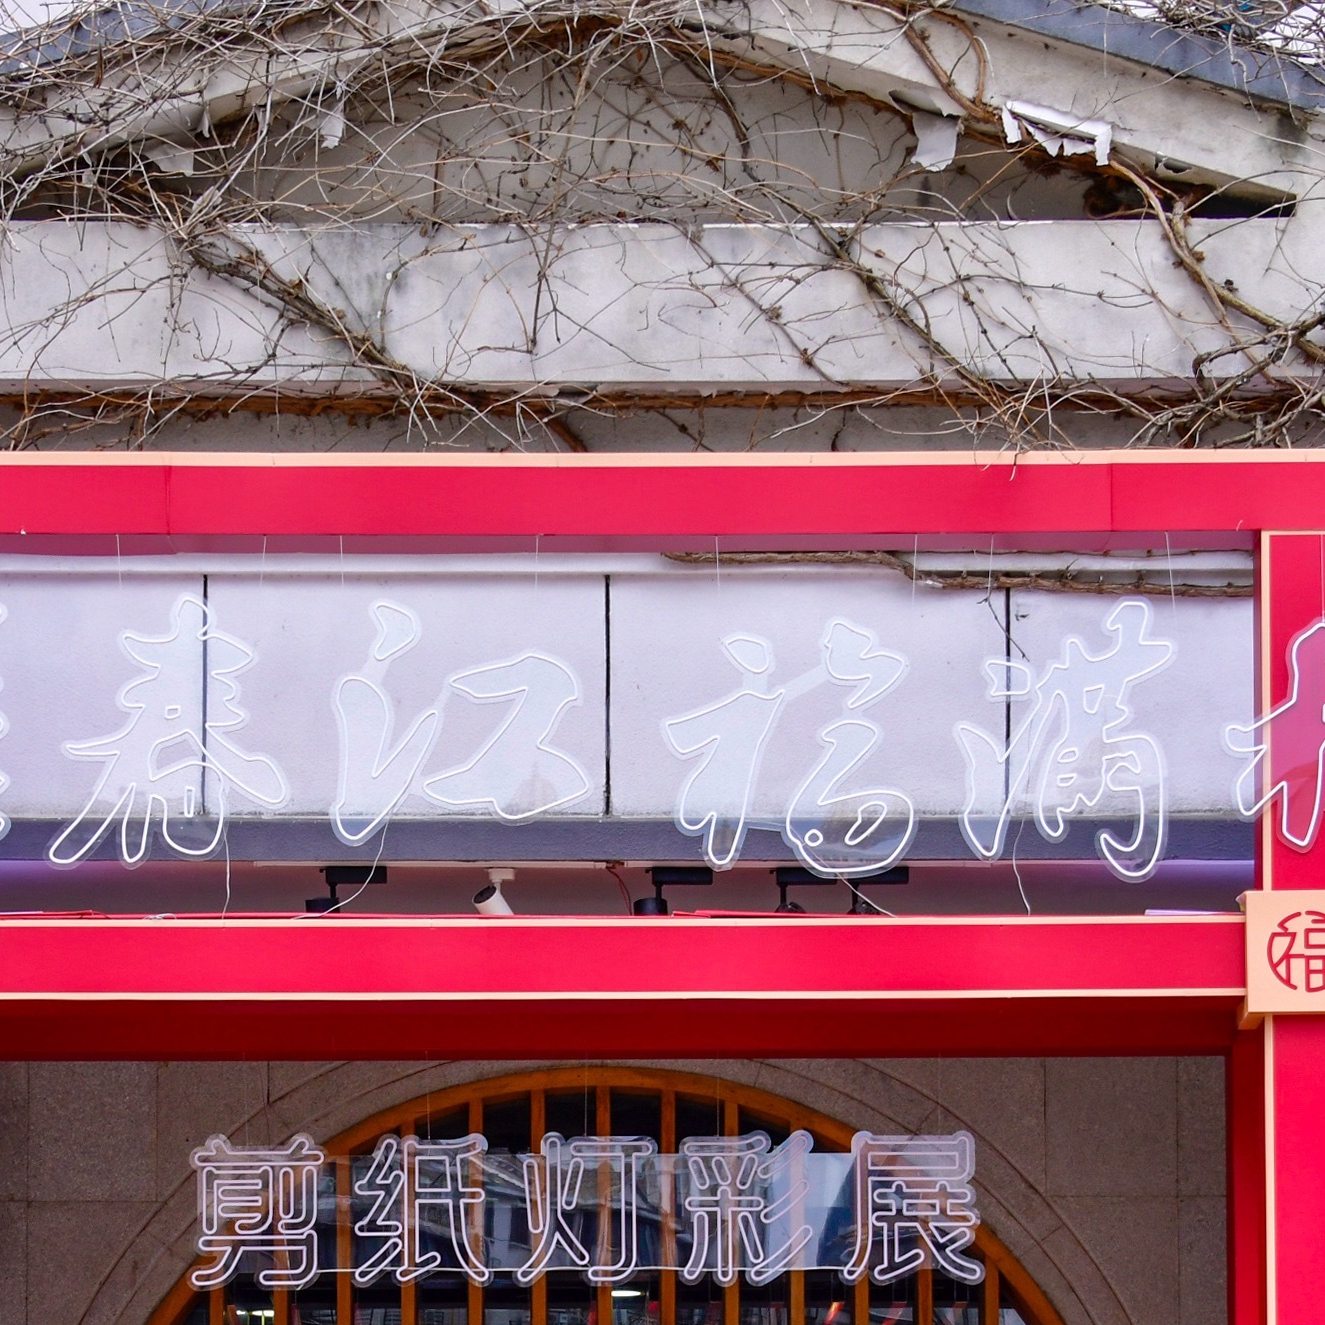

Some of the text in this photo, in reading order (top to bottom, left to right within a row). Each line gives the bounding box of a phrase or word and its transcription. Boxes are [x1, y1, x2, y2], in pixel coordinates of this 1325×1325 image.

[190, 1131, 984, 1288] 剪纸灯彩展
